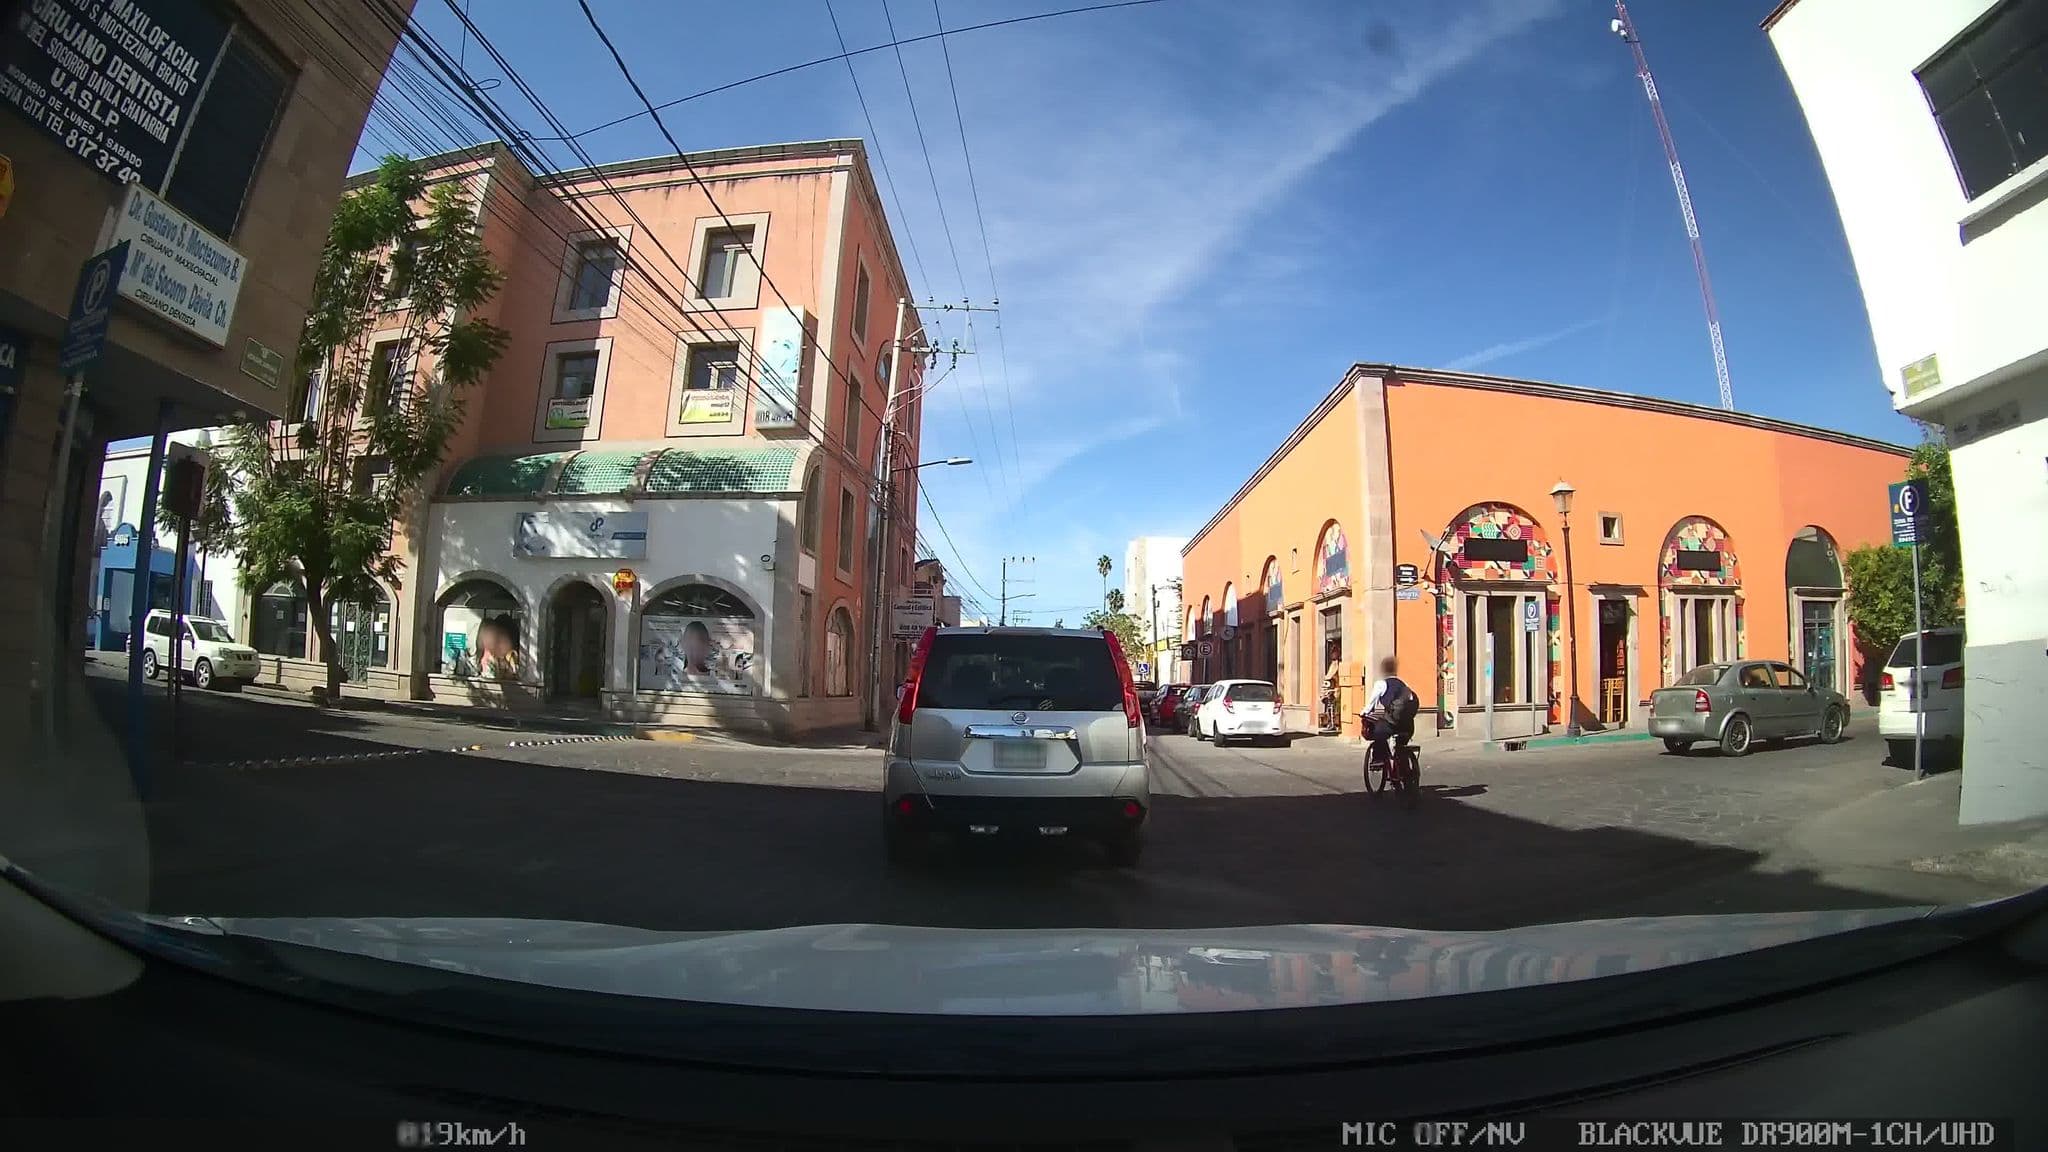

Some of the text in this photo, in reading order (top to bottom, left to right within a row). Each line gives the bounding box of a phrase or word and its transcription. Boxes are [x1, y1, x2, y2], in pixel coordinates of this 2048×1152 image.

[32, 0, 181, 127] CIRUJANO DENTISTA
[98, 11, 157, 72] MOCTEZUMA
[156, 62, 189, 97] BRAVO
[109, 0, 201, 83] MAXILOFACIAL
[0, 74, 23, 105] EVIA
[22, 96, 46, 122] CITA
[45, 112, 64, 136] TEL
[65, 129, 98, 159] 817
[95, 149, 121, 173] 37
[47, 37, 89, 81] SOCORRO
[87, 71, 121, 107] DAVILA
[120, 96, 170, 144] CHAVARRIA
[51, 68, 120, 133] U.A.S.L.P.
[48, 95, 62, 111] DE
[63, 107, 95, 135] LUNES
[96, 131, 104, 142] A
[106, 138, 143, 168] SABADO
[140, 233, 219, 287] CIRUJANO MAXILOFACIAL
[143, 200, 178, 243] Gustavo
[187, 228, 232, 277] Moctezuma
[134, 288, 196, 328] CIRUJANO DENTISTA
[155, 264, 187, 305] Socorro
